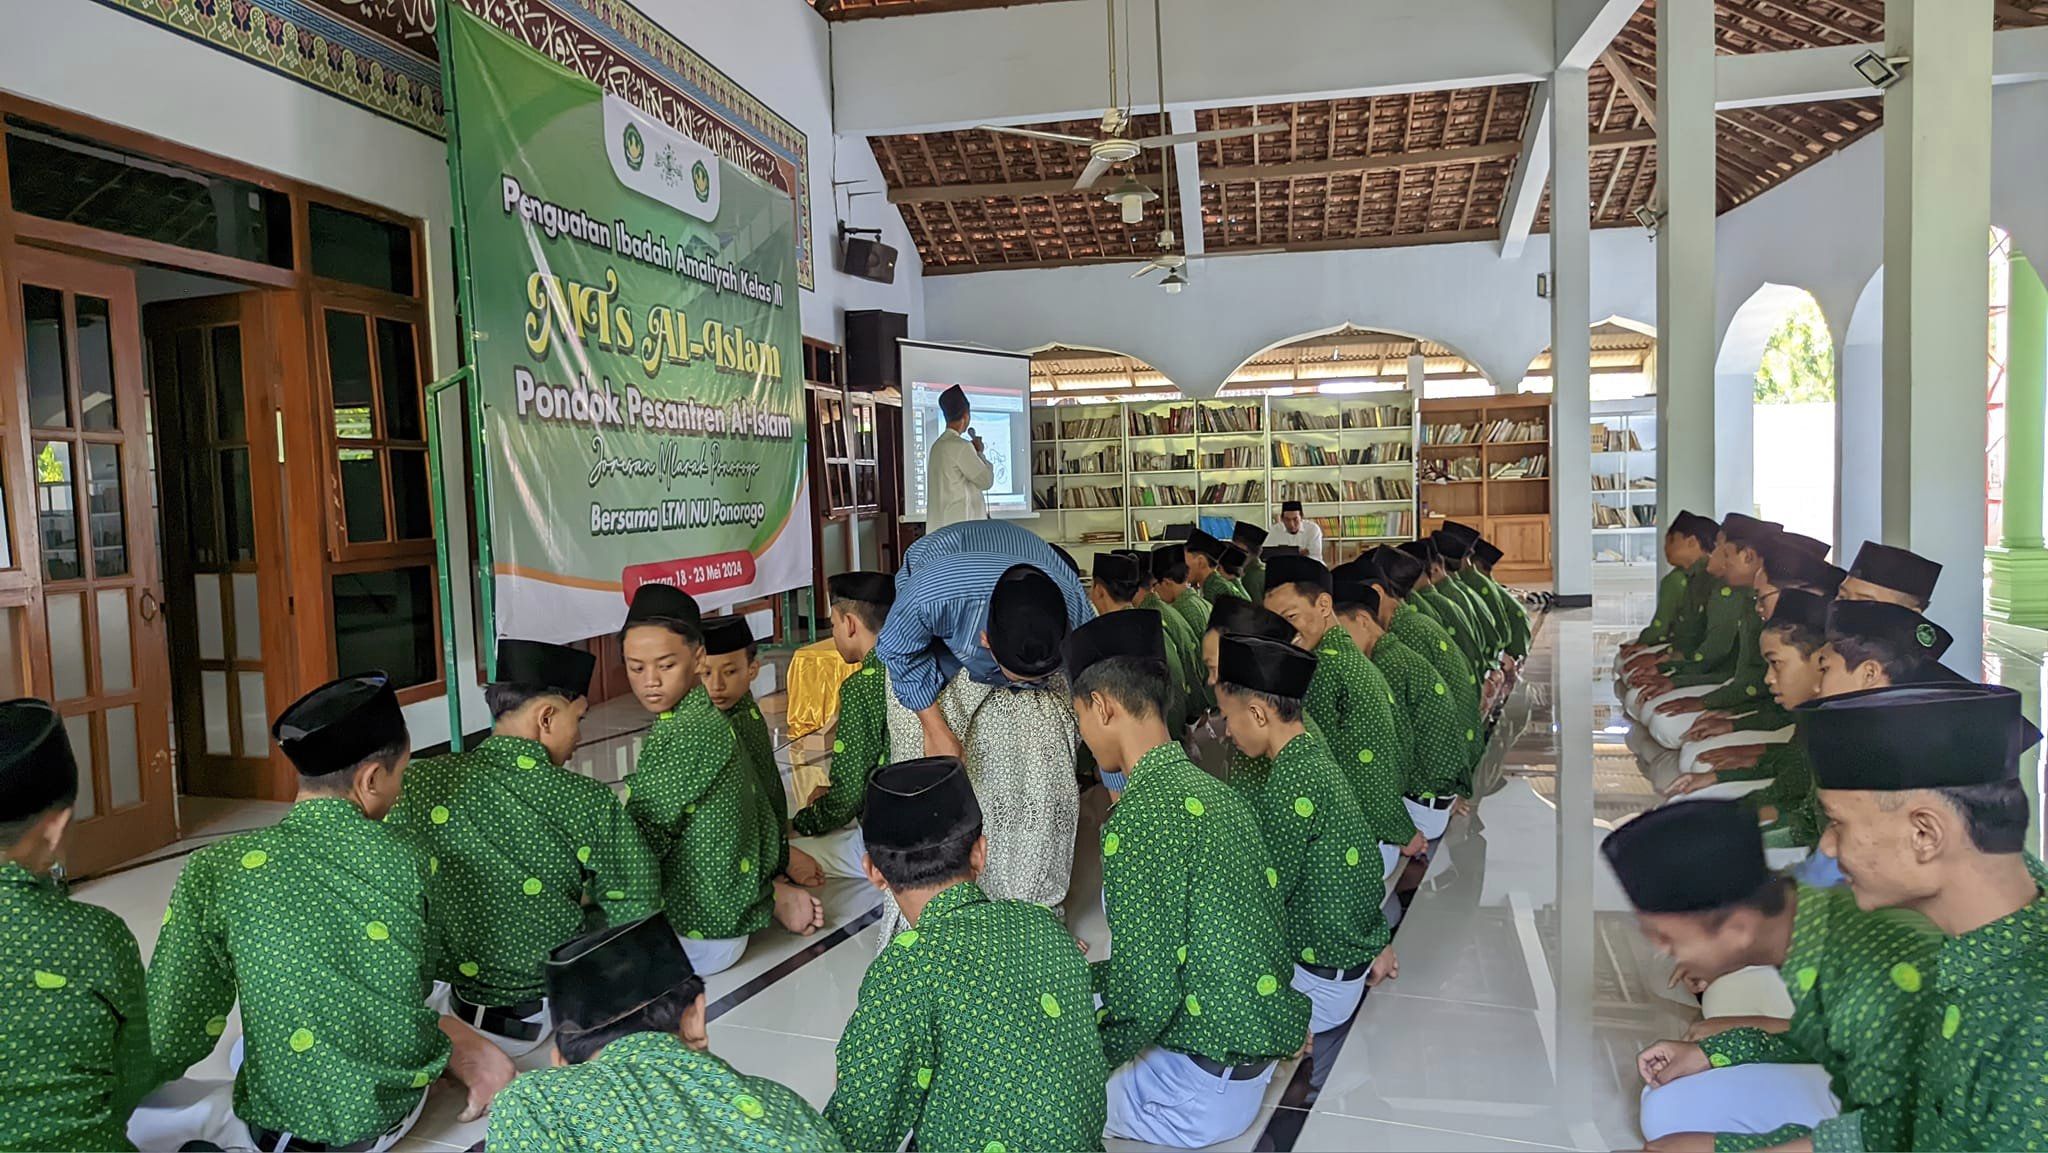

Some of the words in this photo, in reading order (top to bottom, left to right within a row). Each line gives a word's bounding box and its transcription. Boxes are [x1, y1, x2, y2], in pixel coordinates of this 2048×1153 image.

[502, 175, 612, 249] Penguatan
[615, 220, 673, 269] Ibadah
[676, 246, 738, 293] Amaliyah
[740, 270, 772, 303] Kelas
[525, 268, 634, 354] MTs
[641, 306, 781, 378] Al-Islam
[515, 369, 623, 425] Pondok
[626, 387, 726, 433] Pesantren
[731, 400, 792, 438] Al-Islam
[659, 440, 708, 490] Mlarak
[591, 503, 658, 532] Bersama
[662, 501, 686, 527] LTM
[689, 499, 710, 525] NU
[712, 500, 764, 526] Ponorogo
[693, 566, 705, 583] 23
[706, 563, 722, 580] Mei
[722, 561, 743, 578] 2024
